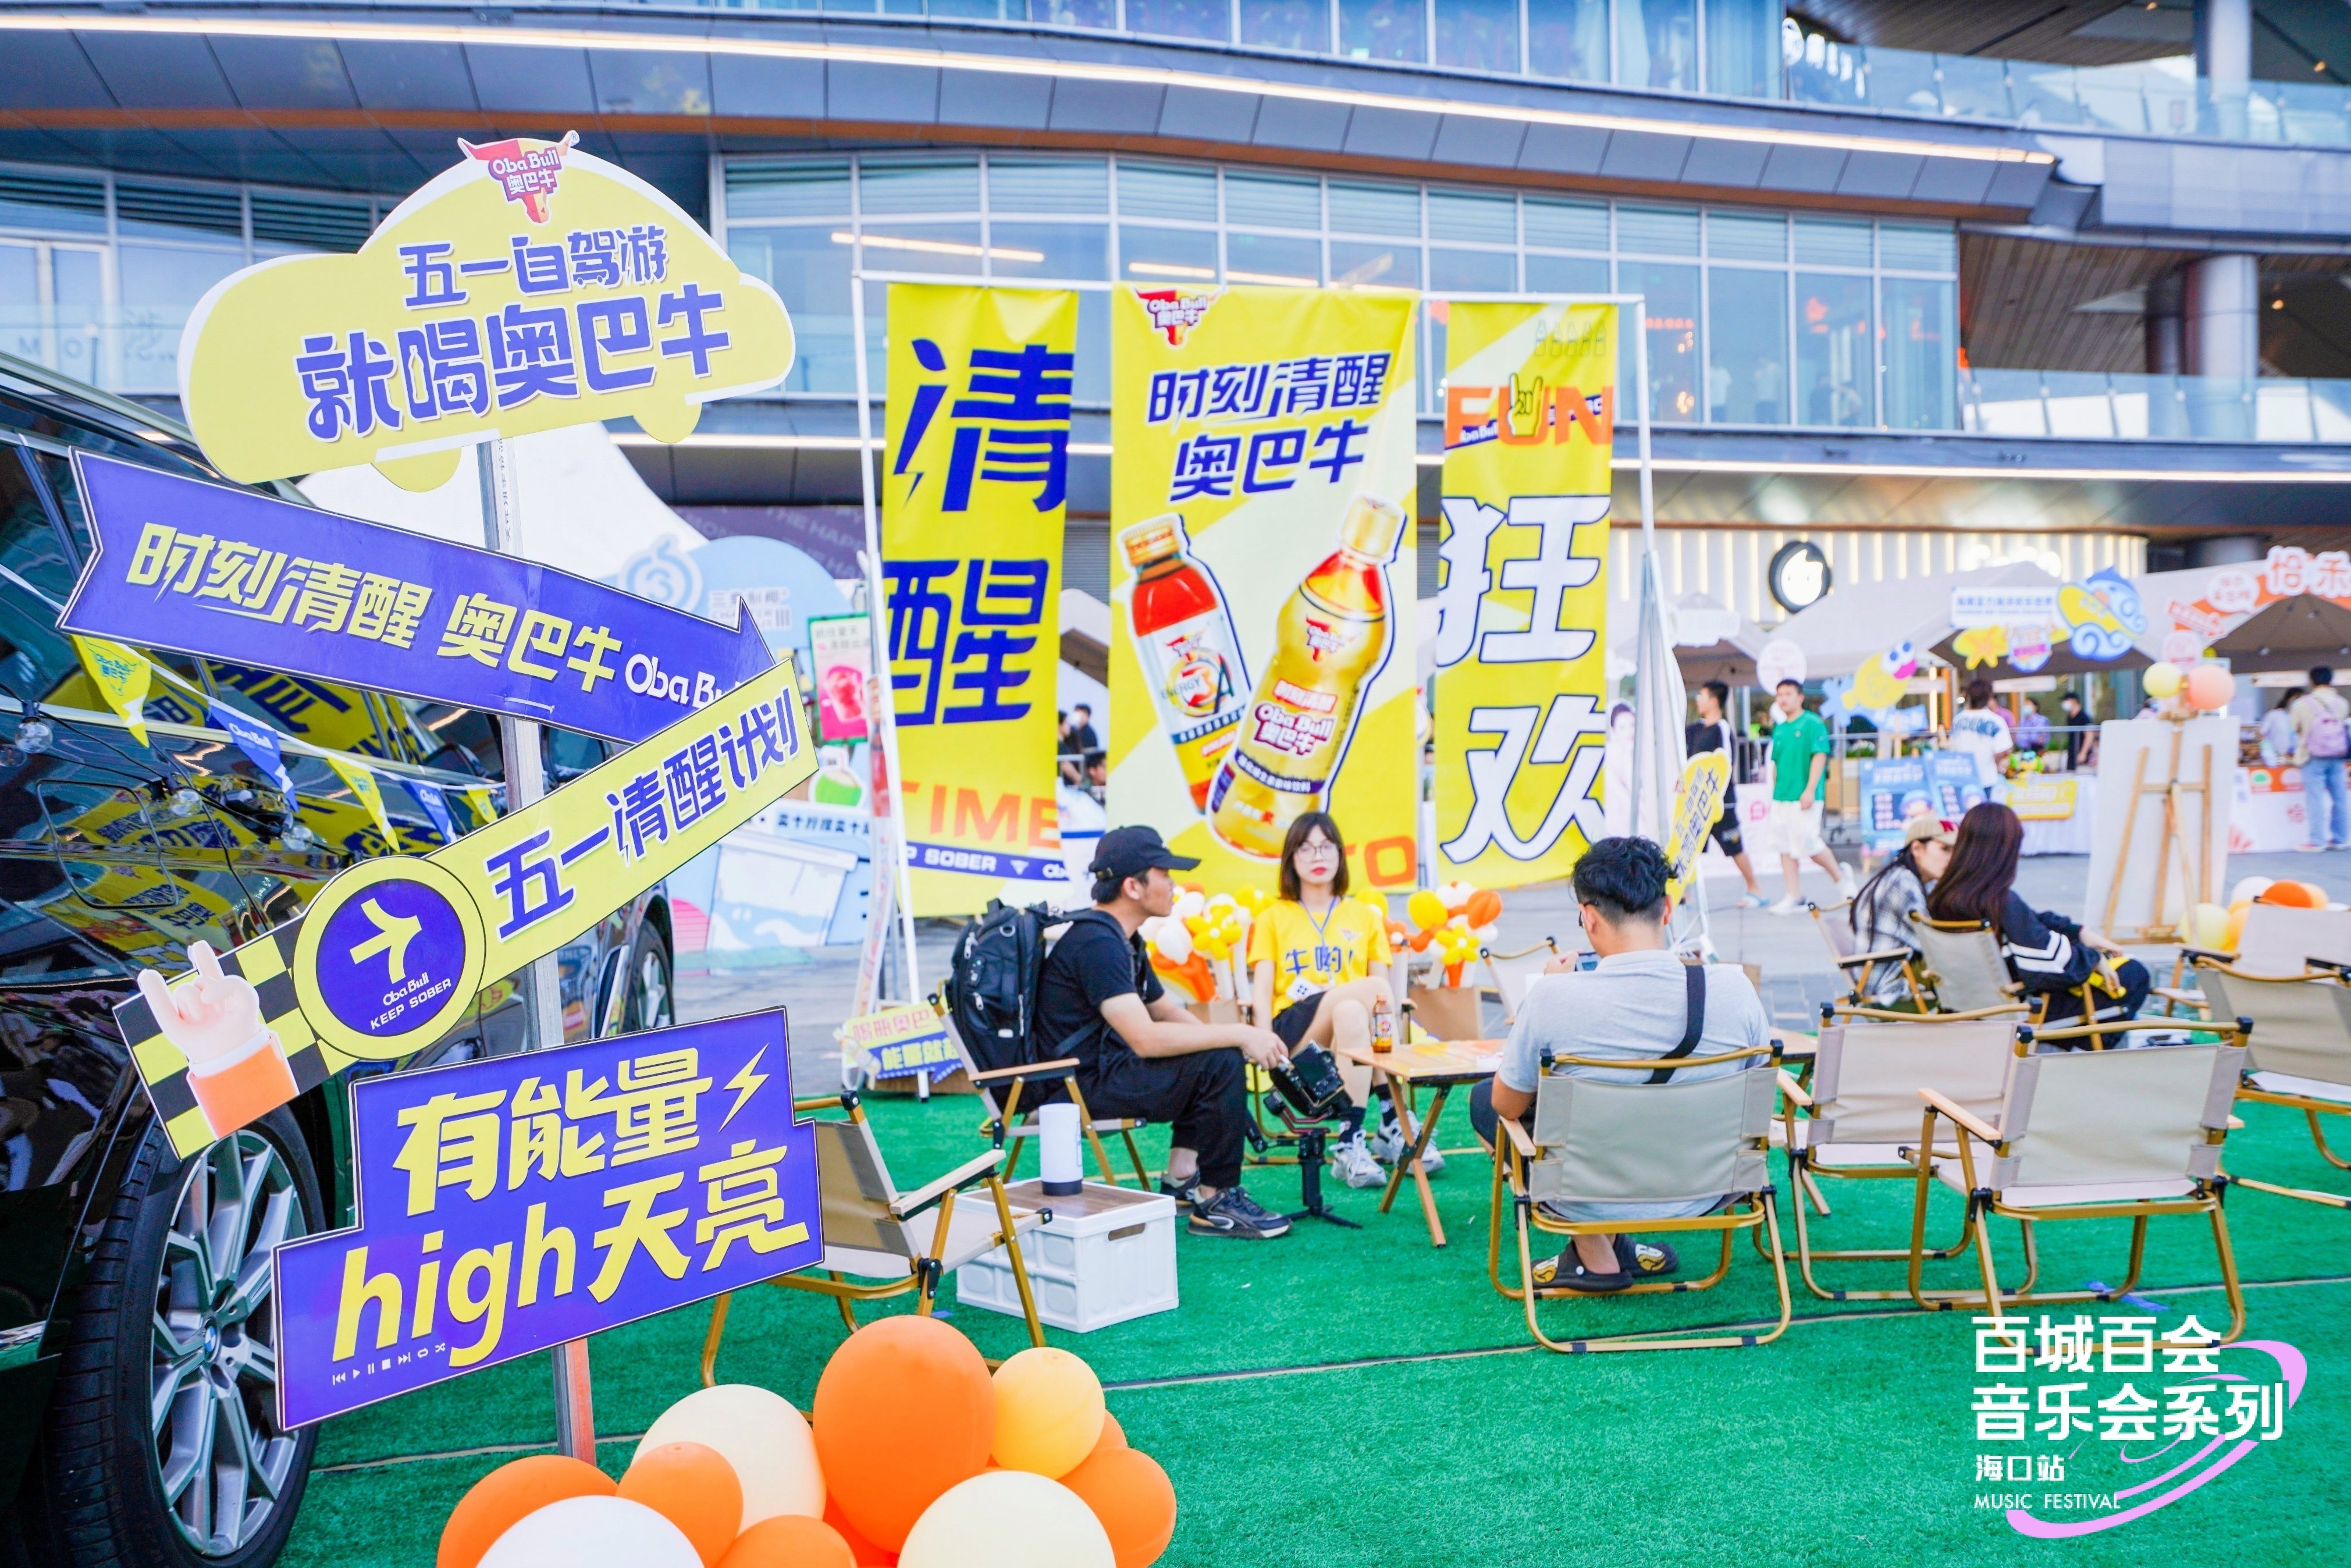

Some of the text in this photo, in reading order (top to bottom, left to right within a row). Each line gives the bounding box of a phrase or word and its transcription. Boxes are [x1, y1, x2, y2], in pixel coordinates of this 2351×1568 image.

[492, 149, 560, 175] Oba Bull
[506, 168, 554, 195] 奥巴牛
[399, 225, 668, 310] 五一自驾游
[1157, 308, 1199, 327] 奥巴牛
[293, 283, 732, 443] 就喝奥巴牛
[1147, 351, 1392, 426] 时刻清醒
[1445, 385, 1614, 447] FUN
[1169, 418, 1370, 503] 奥巴牛
[883, 337, 1075, 728] 清醒
[125, 521, 435, 650] 时刻清醒
[436, 592, 624, 693] 奥巴牛
[625, 653, 690, 705] Oba
[1436, 493, 1612, 865] 狂欢
[1257, 703, 1294, 729] Oba
[1294, 714, 1335, 739] Bull
[1257, 720, 1316, 755] 奥巴牛
[484, 685, 802, 942] 五一清醒计划
[924, 848, 997, 873] SOBER
[1042, 863, 1067, 879] Ob
[370, 978, 451, 1030] KEEP SOBER
[383, 972, 429, 1005] Oba Bull
[392, 1046, 713, 1217] 有能量
[331, 1138, 811, 1368] high天亮
